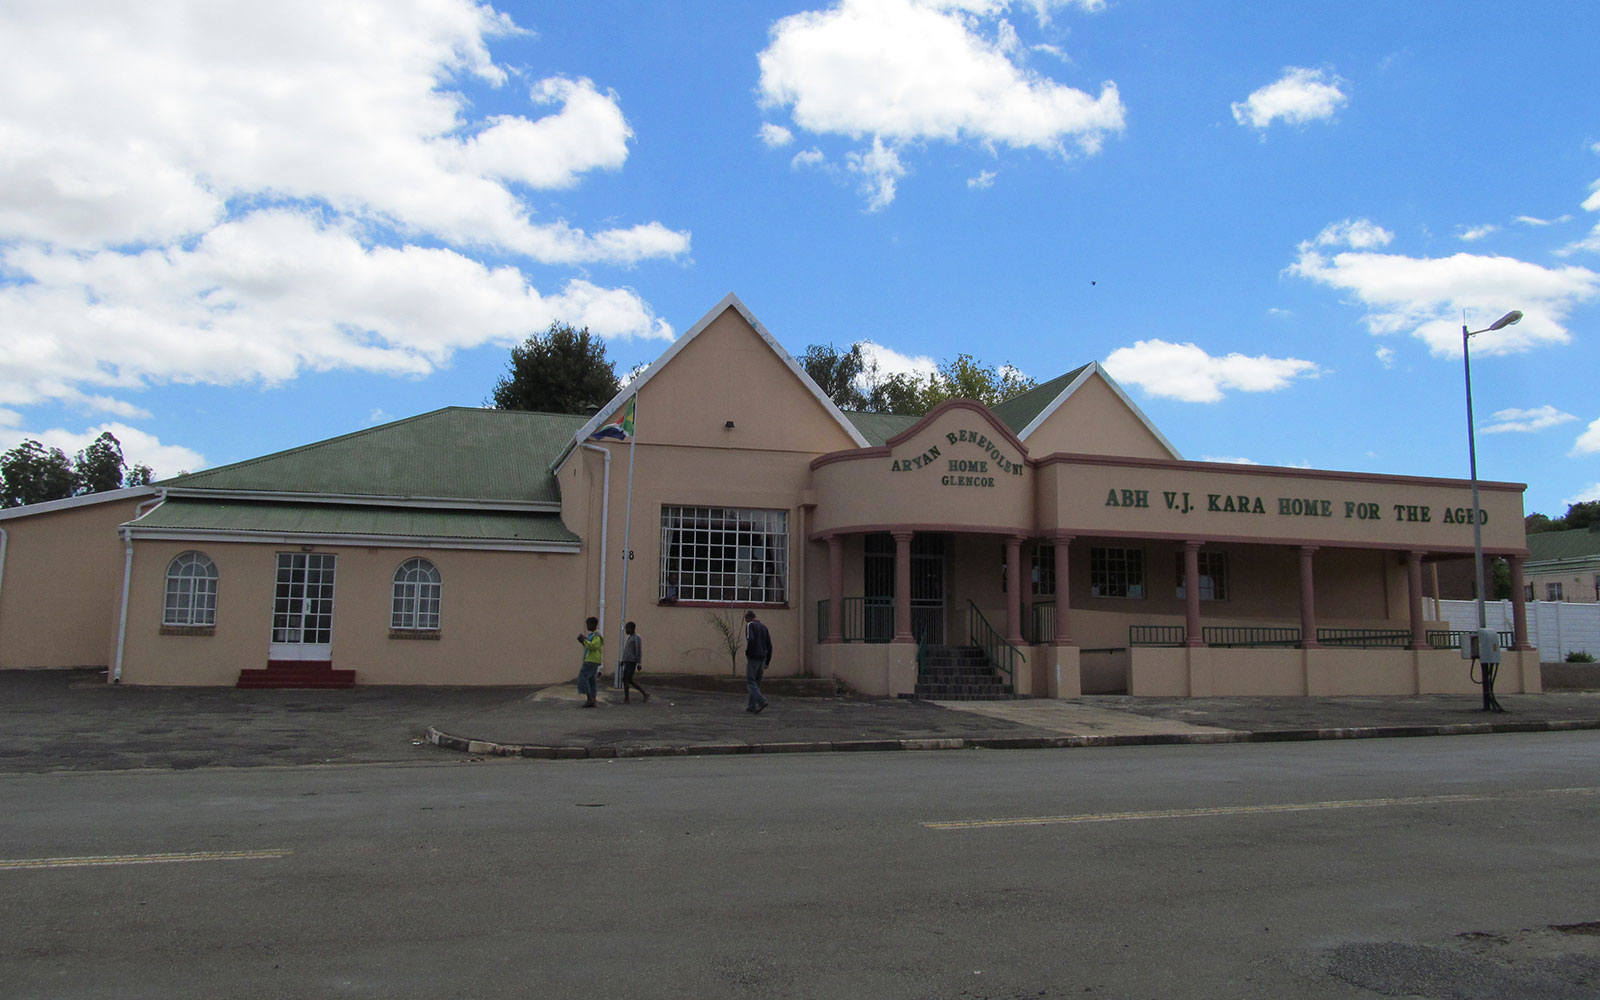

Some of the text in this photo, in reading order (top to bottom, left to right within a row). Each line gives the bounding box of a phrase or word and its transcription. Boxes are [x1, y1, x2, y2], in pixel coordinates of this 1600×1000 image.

[891, 429, 1024, 476] ARYAN BENEVOLENT
[948, 459, 988, 473] HOME
[941, 475, 995, 488] GLENCOE
[1105, 488, 1488, 525] ABH V.J. KARA HOME FOR THE AGED
